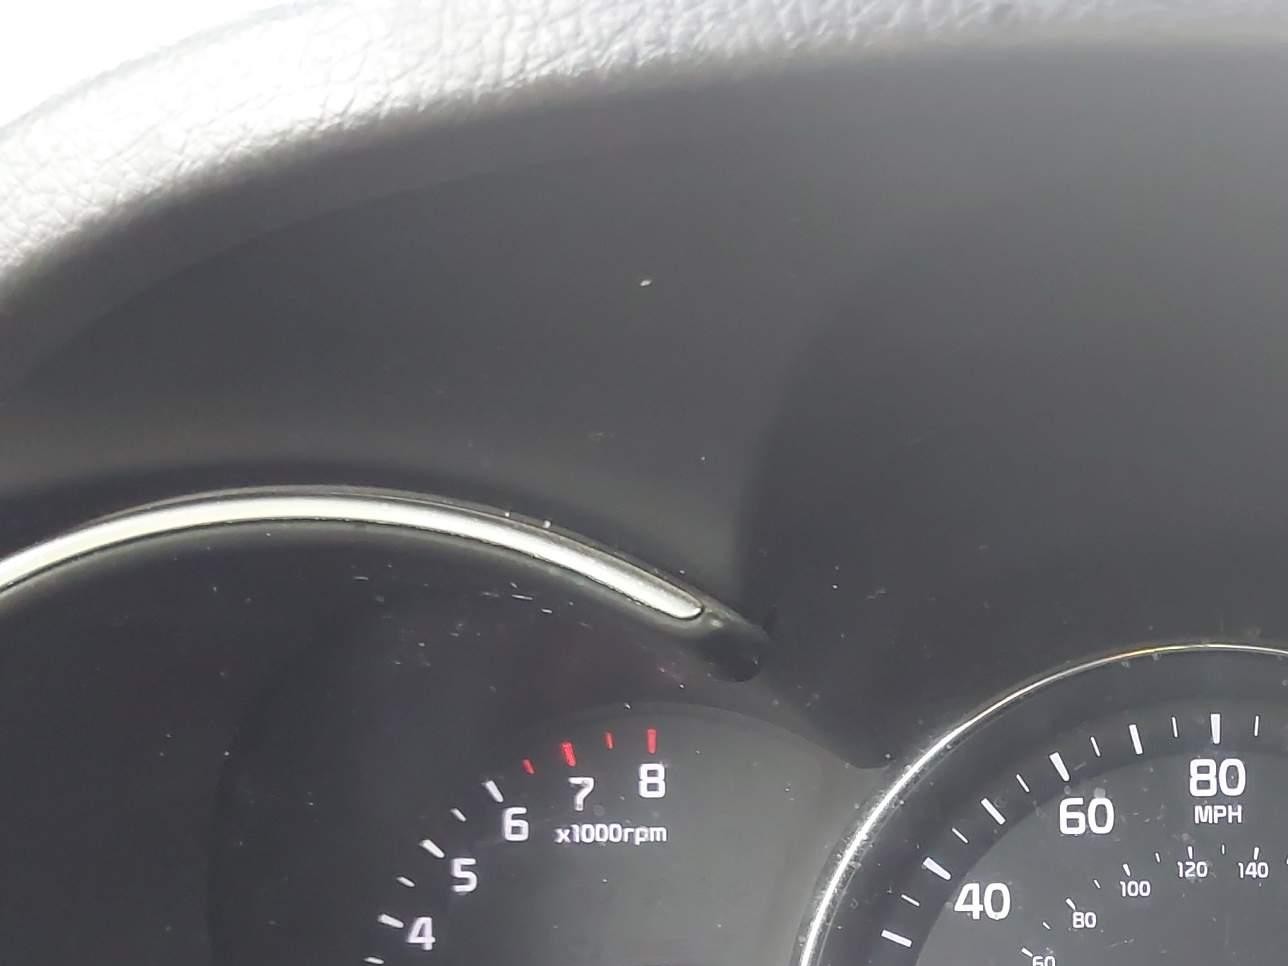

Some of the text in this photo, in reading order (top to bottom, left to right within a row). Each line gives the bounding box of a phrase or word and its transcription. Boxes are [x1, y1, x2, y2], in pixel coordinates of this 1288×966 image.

[569, 776, 595, 811] 7
[638, 763, 666, 798] 8
[1189, 758, 1246, 797] 80
[503, 806, 529, 841] 6
[1059, 796, 1115, 835] 60
[1194, 804, 1242, 824] MPH
[556, 823, 667, 846] x1000rpm
[452, 857, 477, 893] 5
[1177, 861, 1208, 878] 120
[1238, 861, 1268, 880] 140
[954, 882, 1011, 921] 40
[1119, 880, 1151, 897] 100
[407, 916, 436, 951] 4
[1072, 911, 1097, 929] 80
